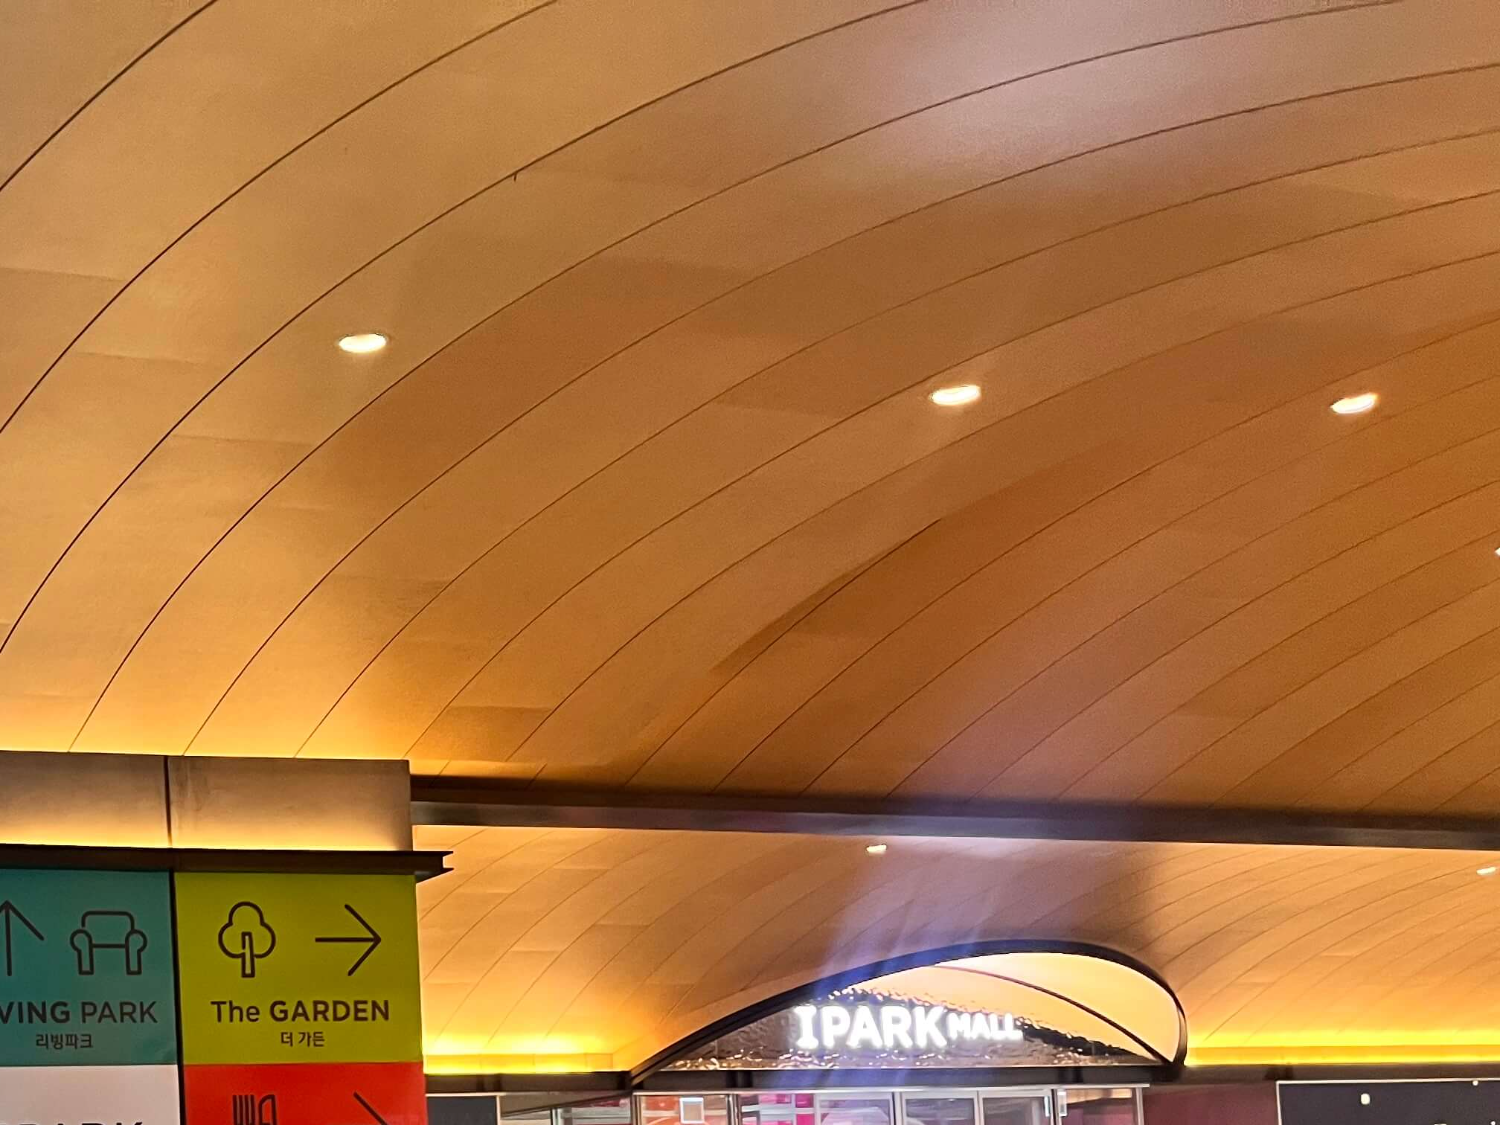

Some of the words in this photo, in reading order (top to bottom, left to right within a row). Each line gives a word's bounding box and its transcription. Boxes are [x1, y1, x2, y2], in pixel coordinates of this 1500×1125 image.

[81, 1000, 159, 1024] PARK
[211, 1000, 260, 1023] The
[269, 999, 390, 1022] GARDEN
[947, 1011, 1025, 1041] MALL
[36, 1033, 94, 1050] 리빙파크
[280, 1031, 294, 1047] 더
[298, 1031, 326, 1047] 가든
